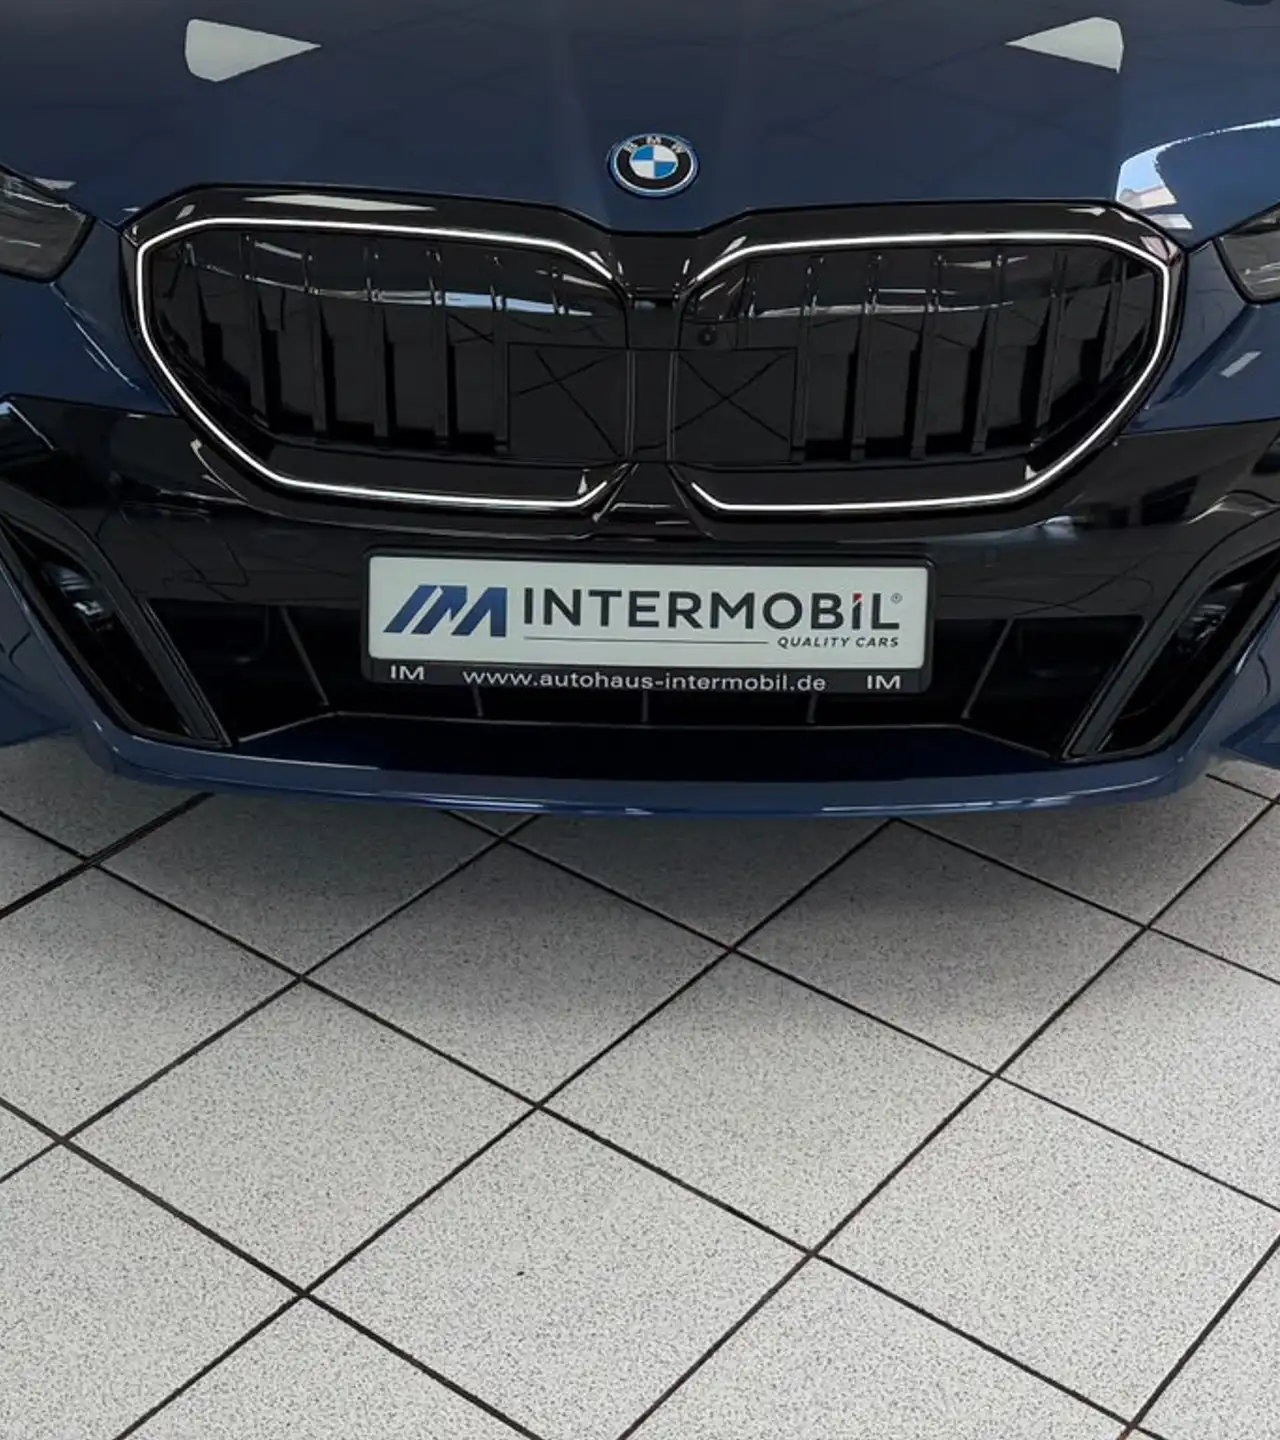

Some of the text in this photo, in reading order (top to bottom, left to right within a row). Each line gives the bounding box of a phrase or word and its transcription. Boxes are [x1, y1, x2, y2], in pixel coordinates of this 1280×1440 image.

[777, 636, 900, 649] QUALITY CARS
[390, 664, 902, 691] IM www.autohaus-intermobil.de IM
